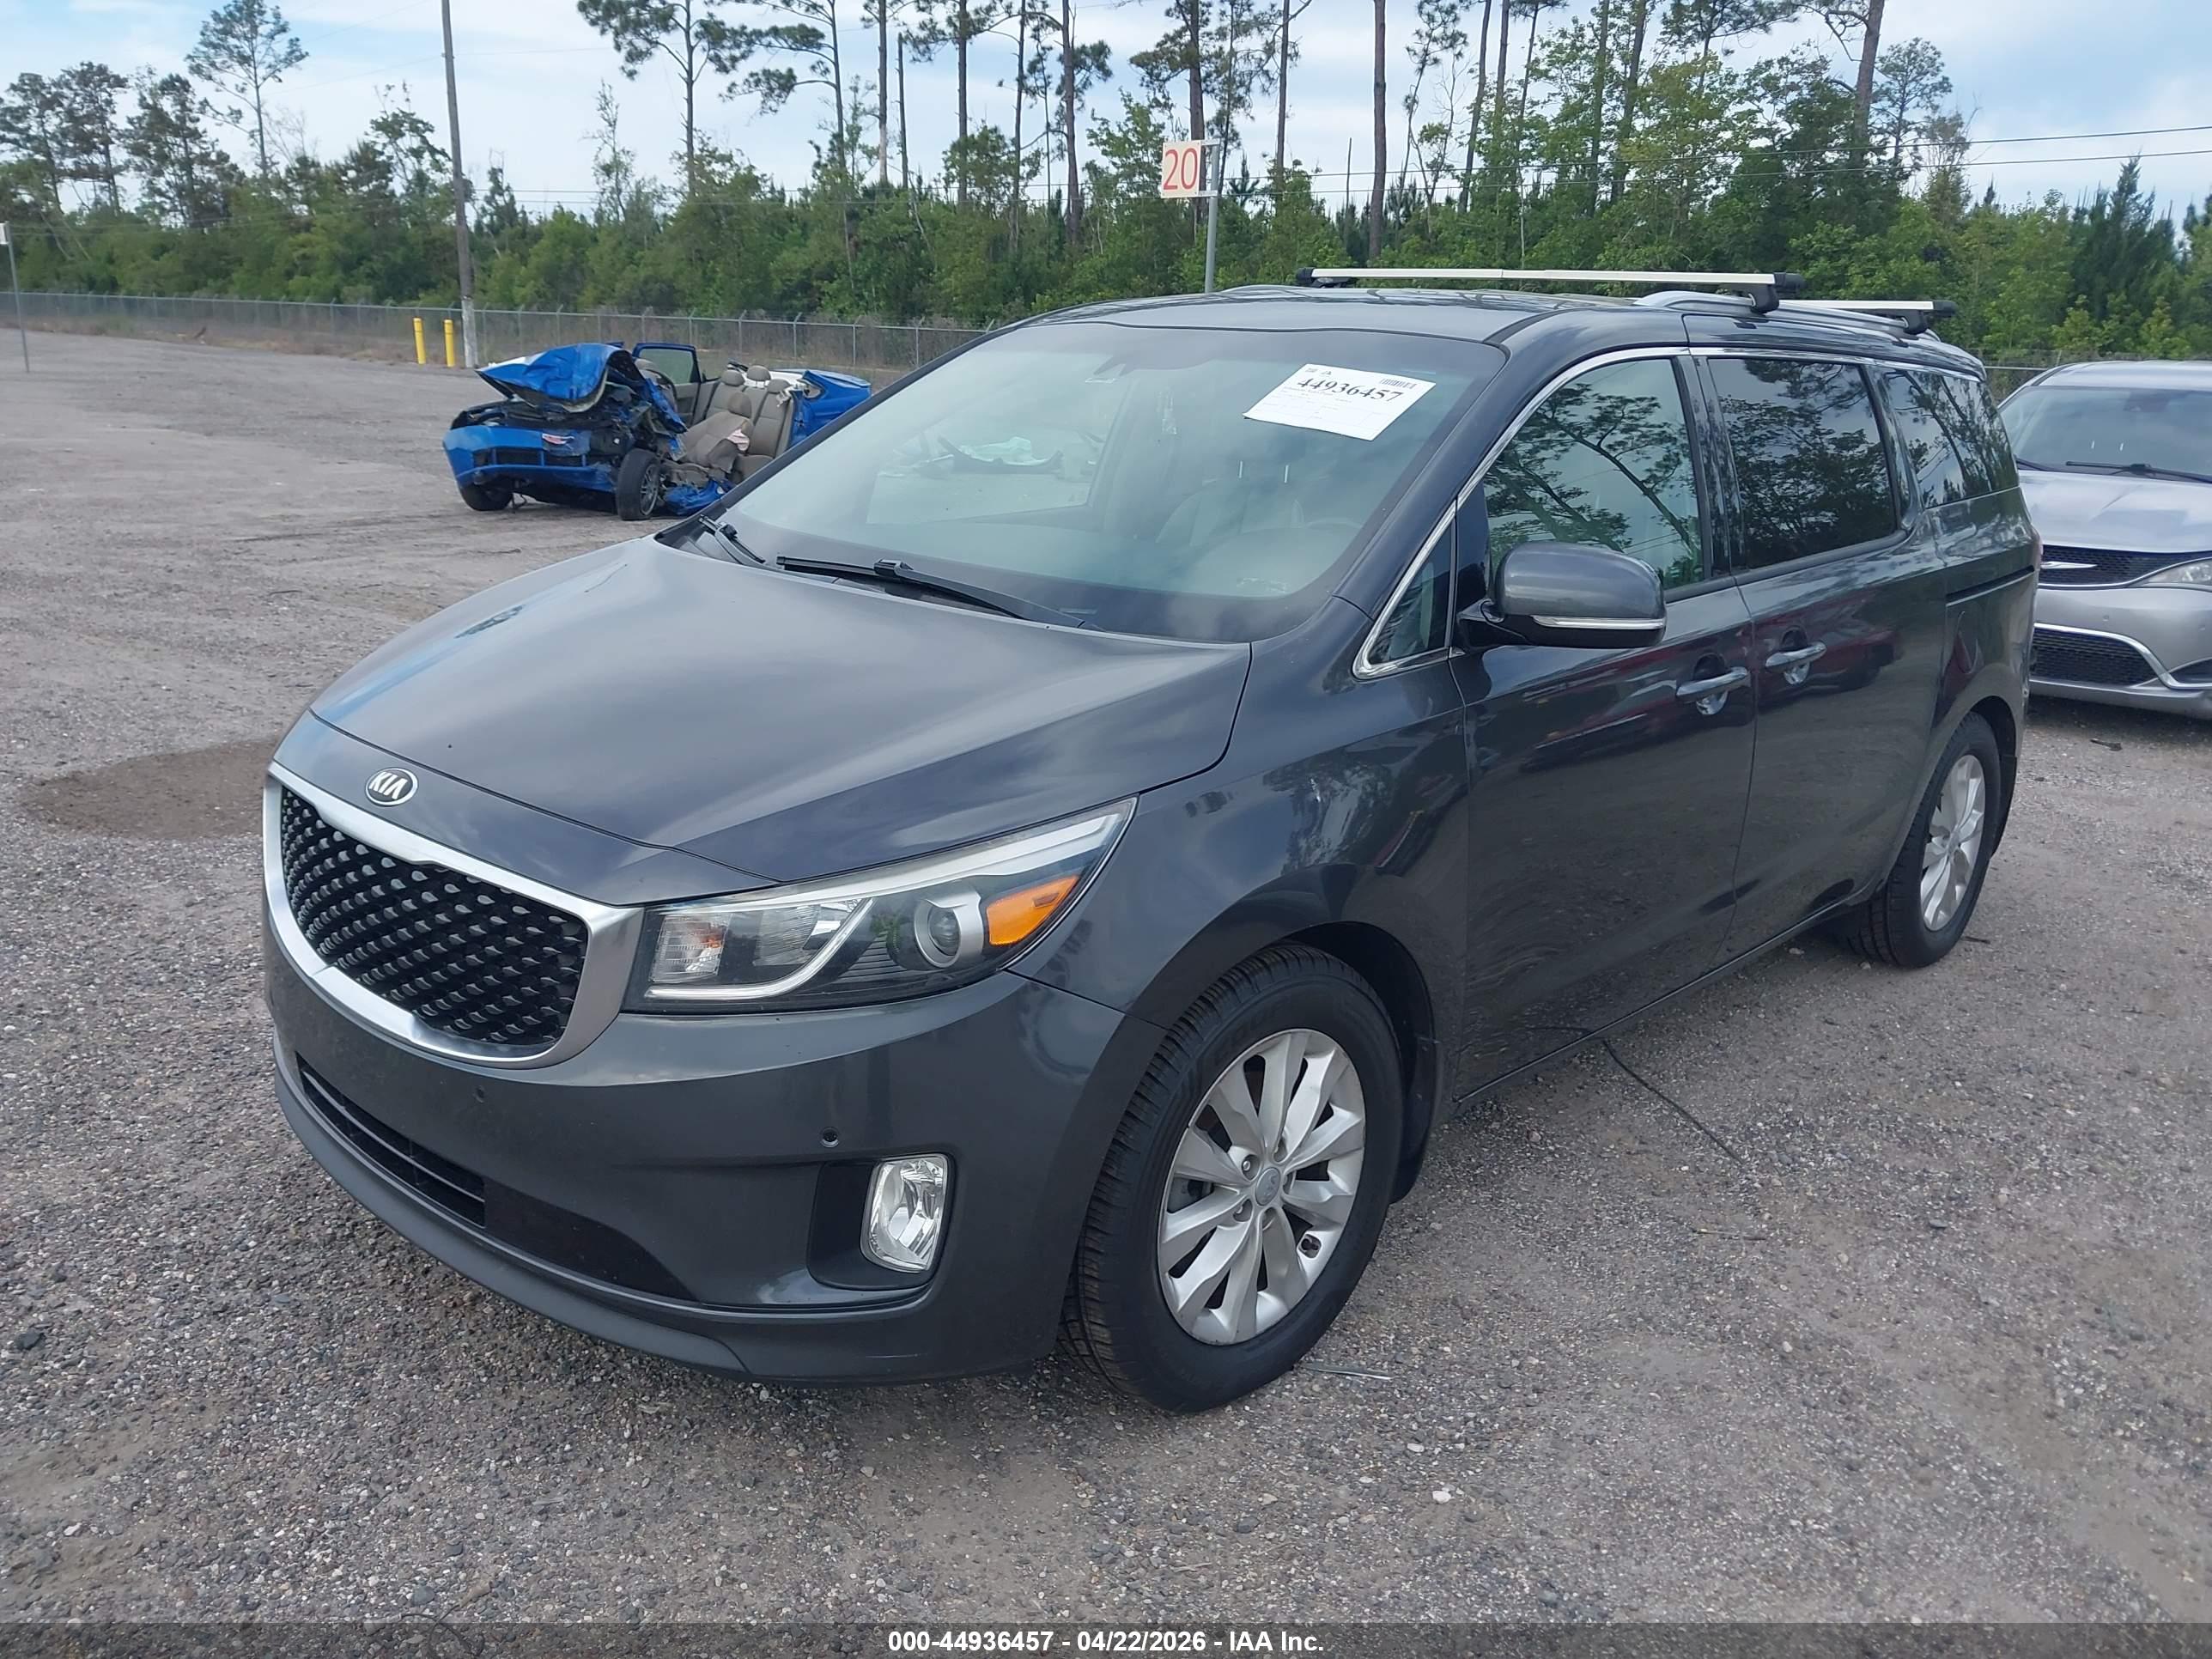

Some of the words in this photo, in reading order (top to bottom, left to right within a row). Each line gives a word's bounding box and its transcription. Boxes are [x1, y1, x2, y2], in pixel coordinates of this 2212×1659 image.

[1163, 148, 1199, 191] 20
[1297, 378, 1404, 402] 44936457
[368, 771, 409, 800] KIA
